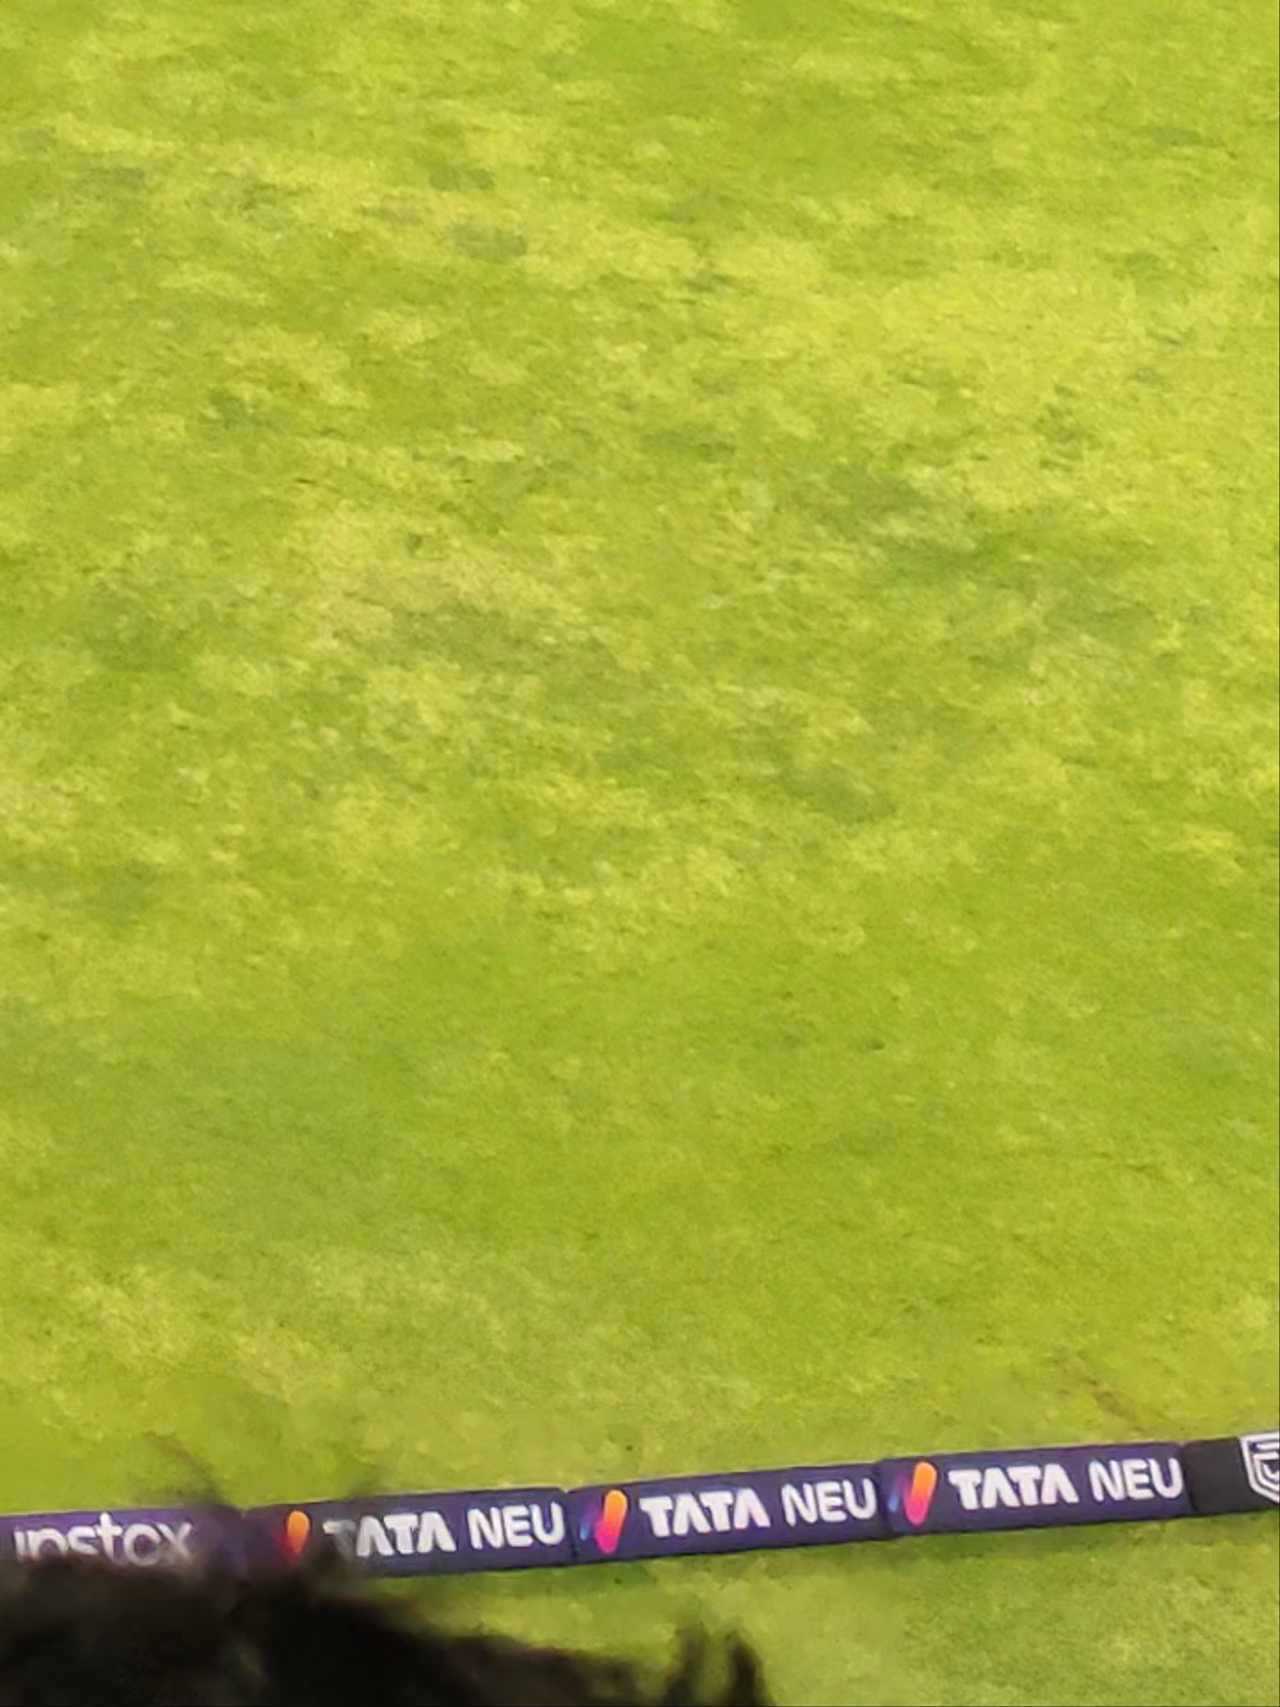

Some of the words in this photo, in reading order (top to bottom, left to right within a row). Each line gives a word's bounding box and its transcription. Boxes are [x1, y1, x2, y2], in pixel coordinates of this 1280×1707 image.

[639, 1488, 770, 1538] TATA
[780, 1478, 878, 1528] NEU
[947, 1463, 1079, 1510] TATA
[1087, 1457, 1183, 1504] NEU
[467, 1501, 564, 1550] NEU
